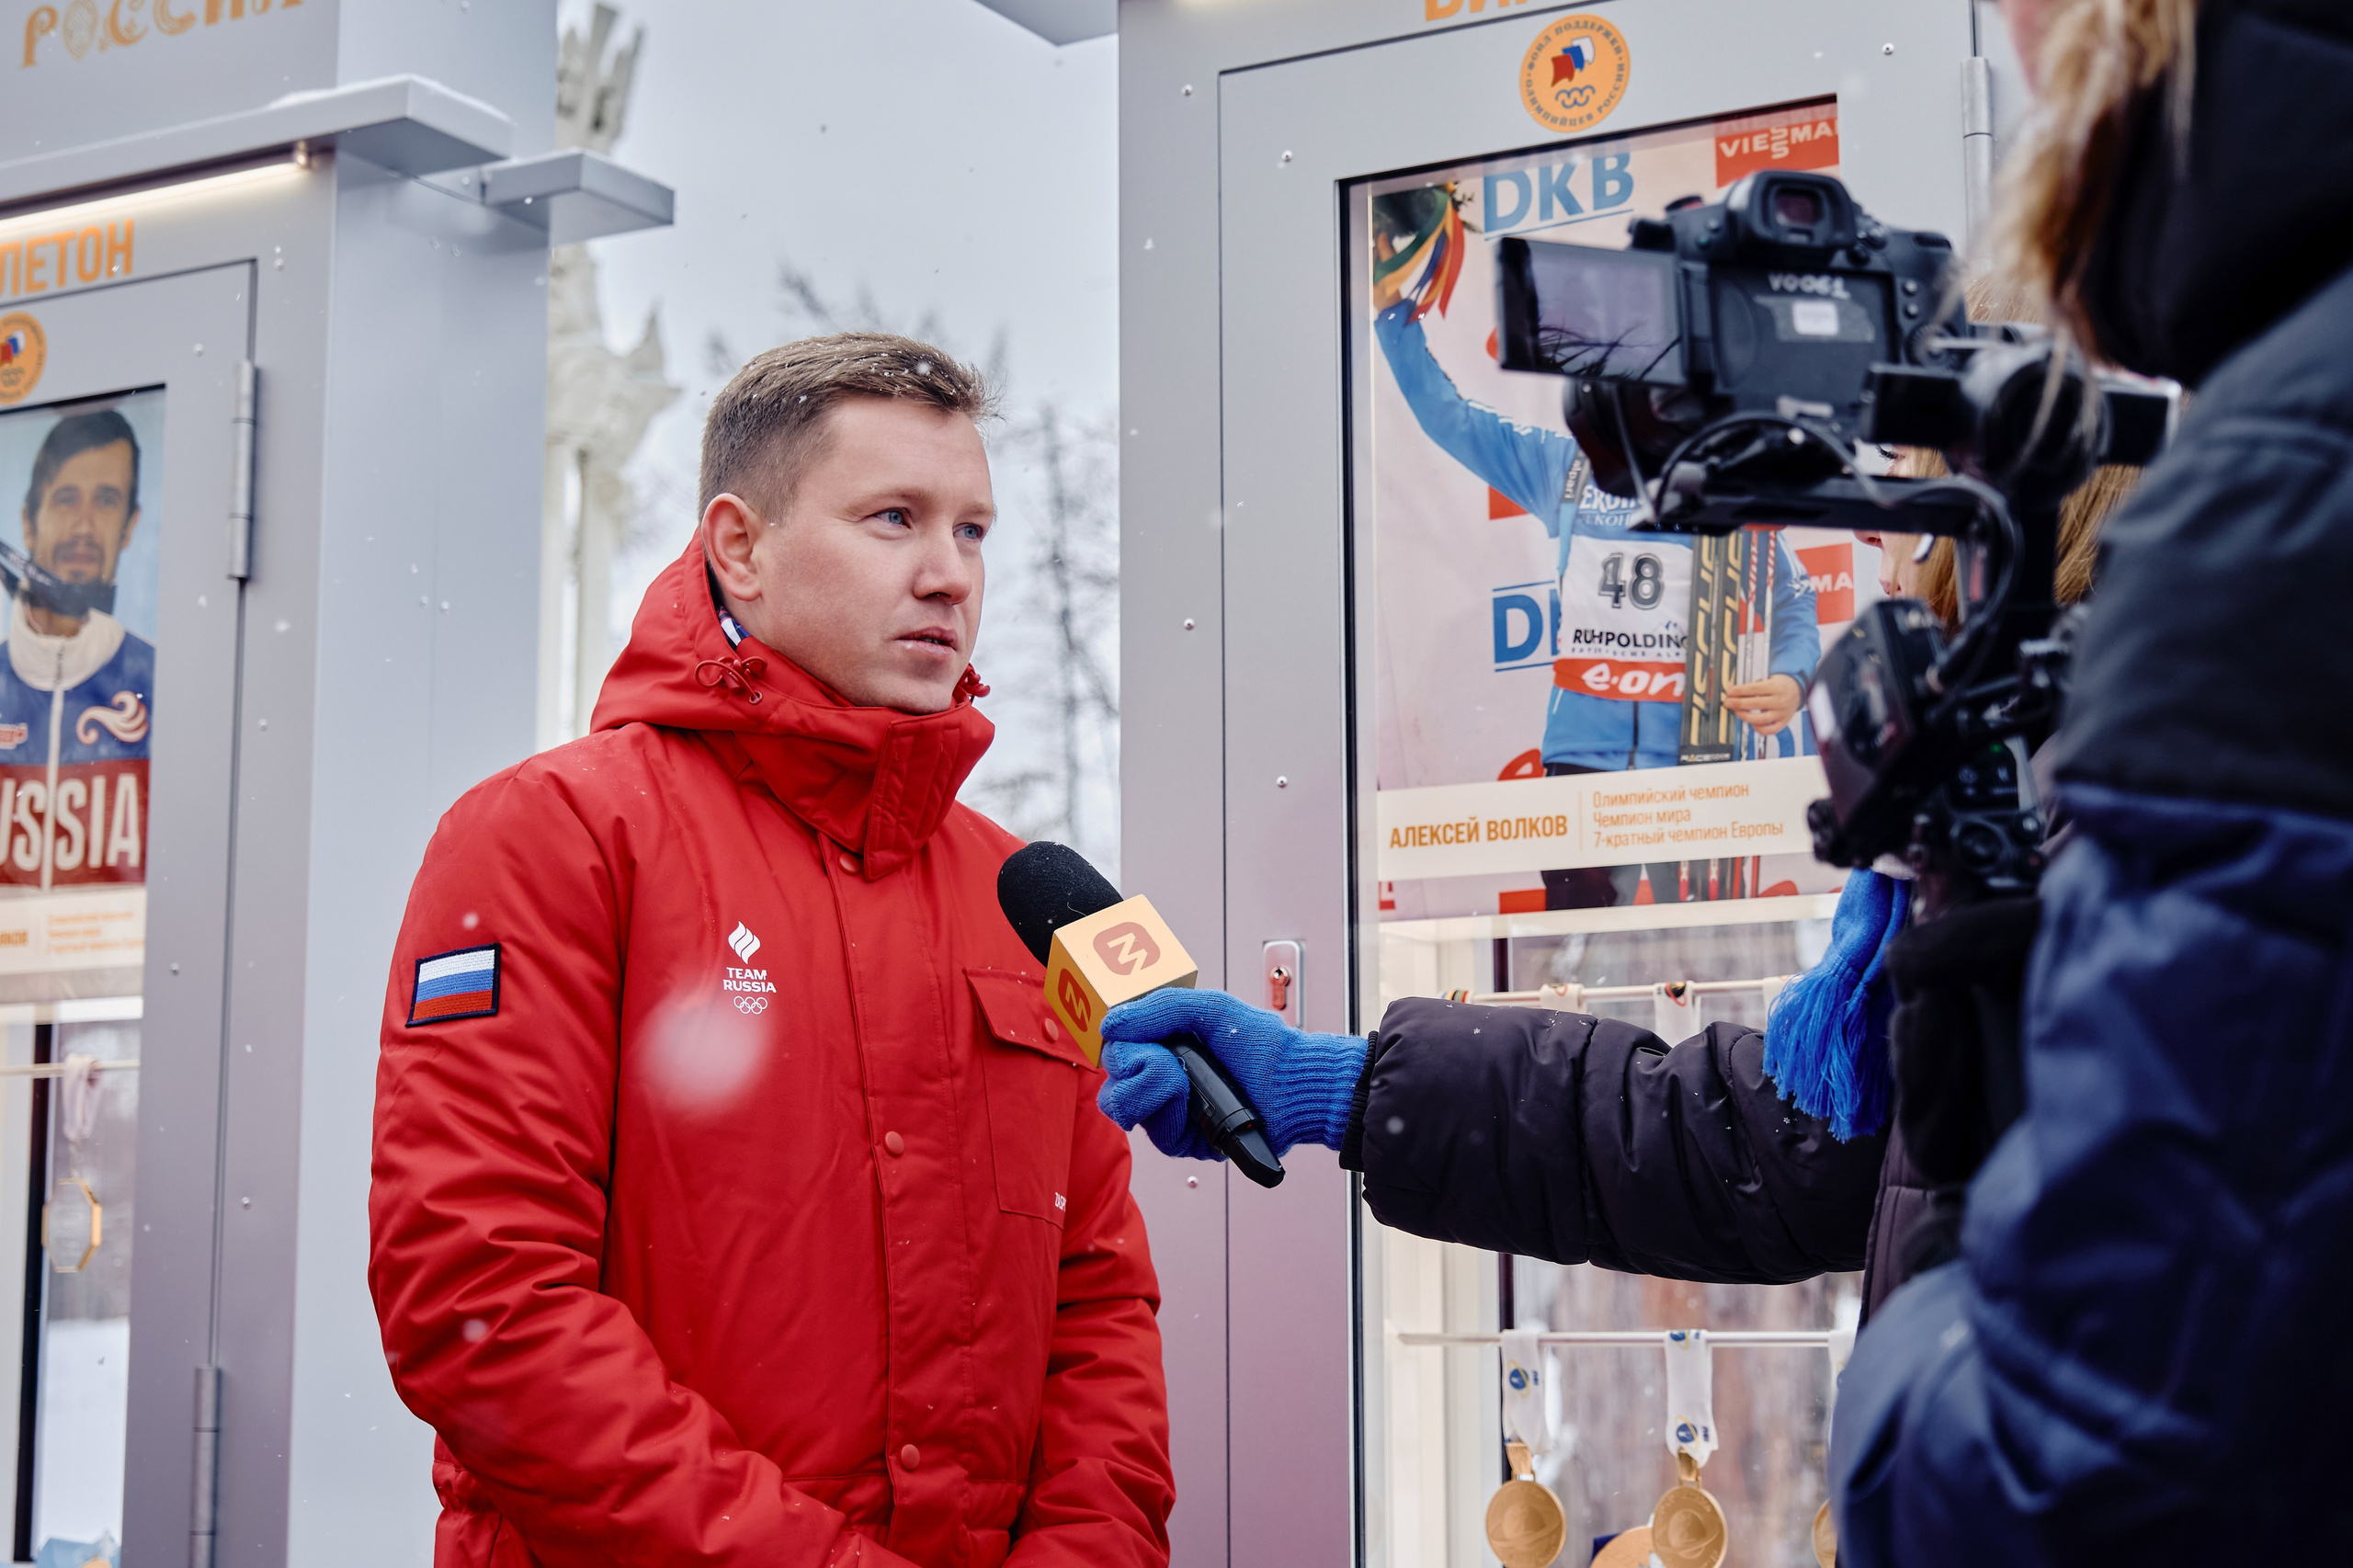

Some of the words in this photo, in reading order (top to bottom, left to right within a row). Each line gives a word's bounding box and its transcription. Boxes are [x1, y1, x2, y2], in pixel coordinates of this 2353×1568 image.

[1597, 62, 1625, 114] РОССИИ
[1719, 119, 1838, 160] VIESSMA
[1483, 151, 1634, 233] DKB
[1598, 552, 1665, 610] 48
[1593, 785, 1687, 809] Олимпийский
[1689, 784, 1750, 801] чемпион
[1389, 815, 1480, 849] АЛЕКСЕЙ
[1486, 814, 1568, 842] ВОЛКОВ
[1593, 811, 1653, 827] Чемпион
[1656, 809, 1691, 825] мира
[1594, 827, 1665, 849] 7-кратный
[1668, 826, 1728, 843] чемпион
[1731, 821, 1784, 841] Европы
[722, 979, 778, 994] RUSSIA
[726, 966, 767, 981] TEAM
